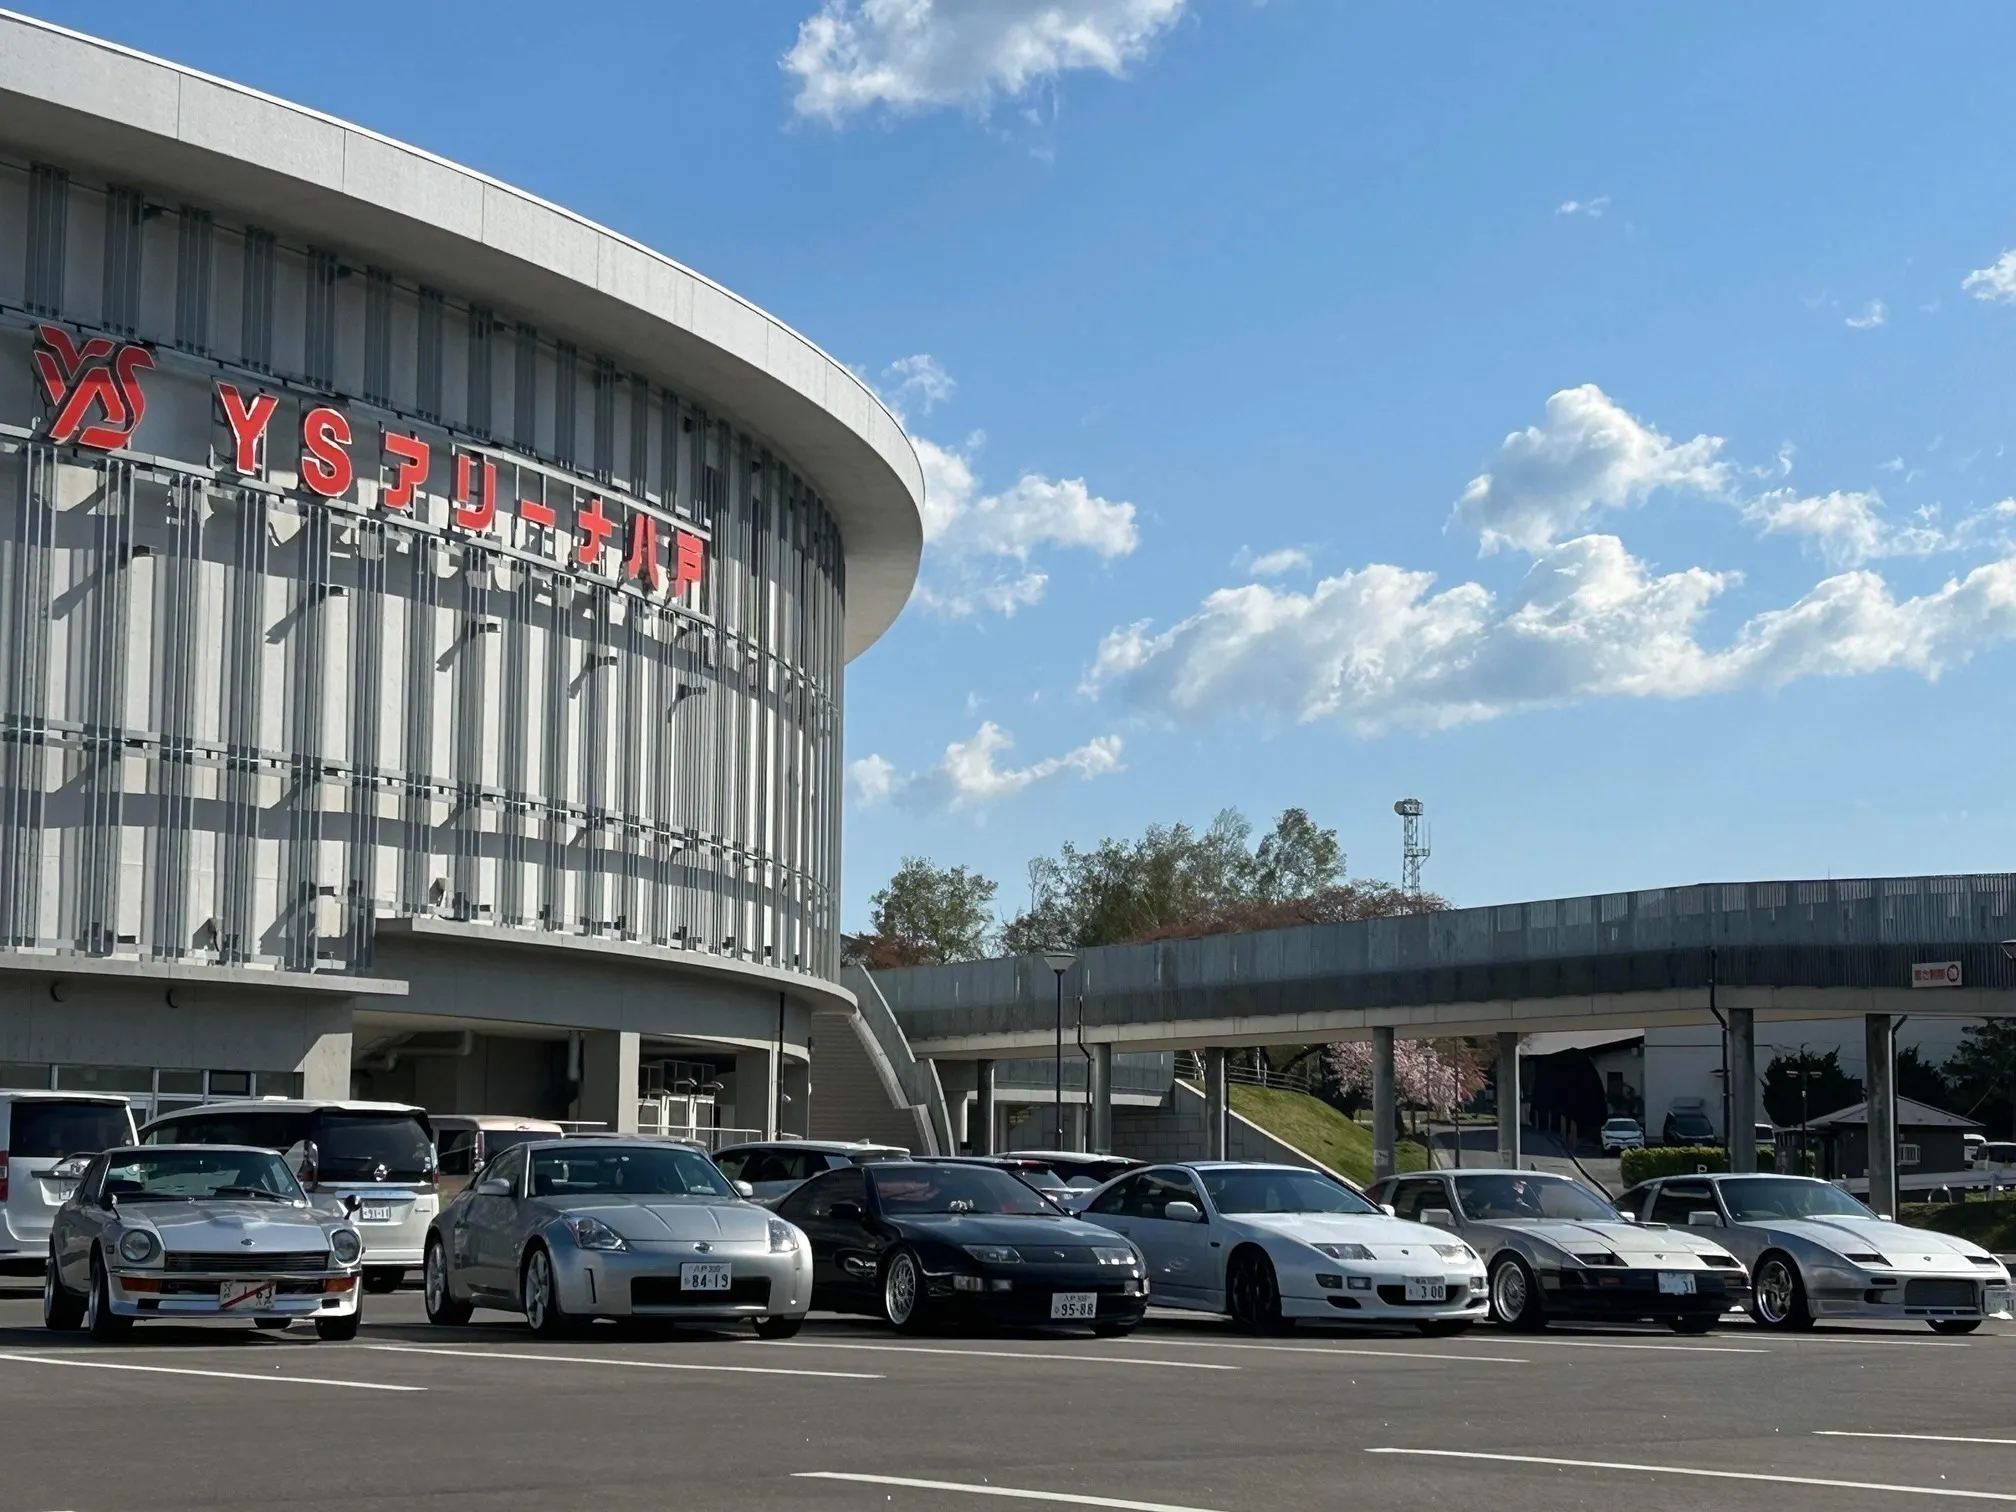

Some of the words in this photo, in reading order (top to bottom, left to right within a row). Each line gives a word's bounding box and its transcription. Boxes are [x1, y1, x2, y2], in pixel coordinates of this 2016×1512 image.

[216, 382, 704, 598] YSアリーナ八戸
[692, 1273, 729, 1289] 84-19
[1061, 1302, 1094, 1316] 95-88
